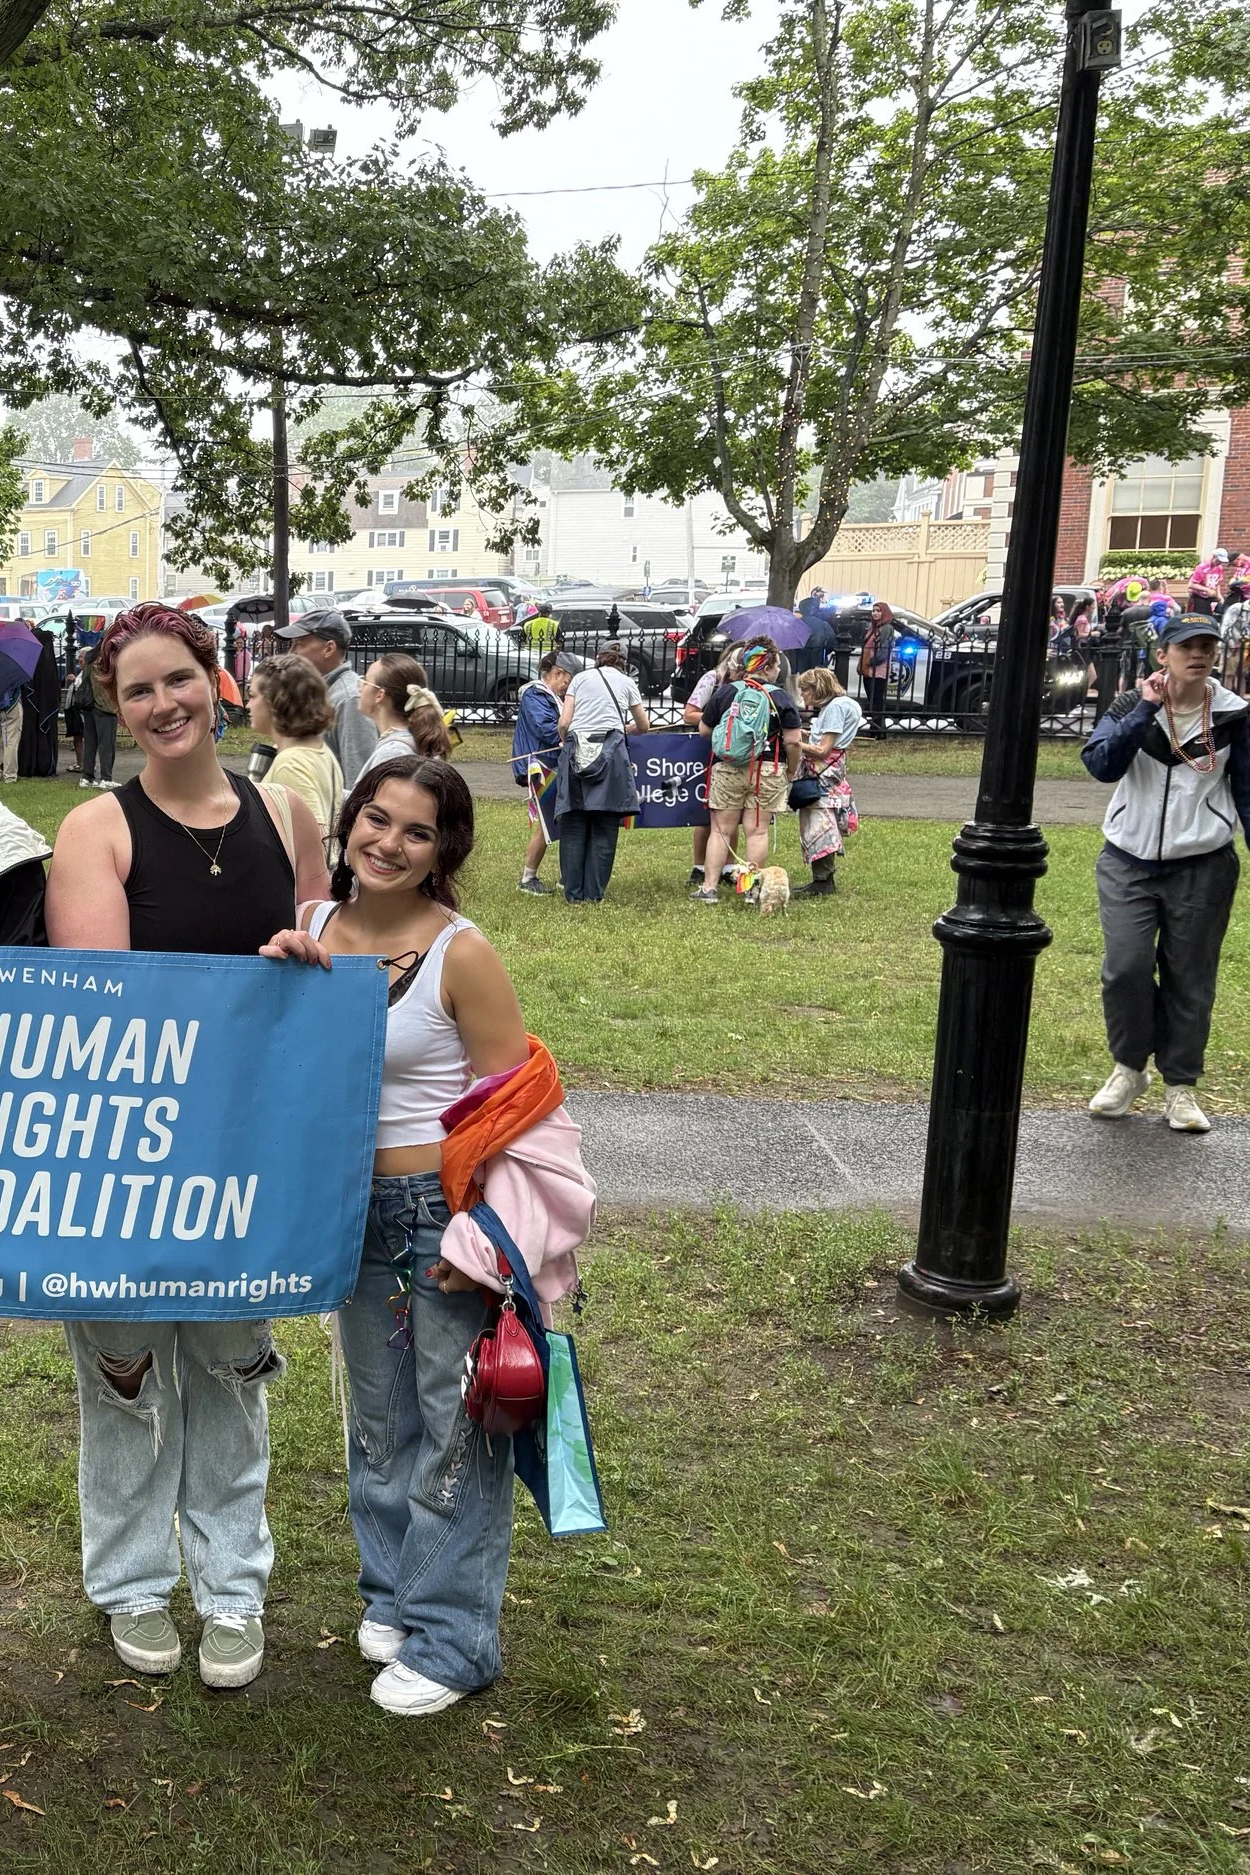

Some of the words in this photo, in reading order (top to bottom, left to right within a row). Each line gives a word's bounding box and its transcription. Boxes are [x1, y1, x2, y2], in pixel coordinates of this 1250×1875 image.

[646, 757, 704, 777] Shore
[636, 784, 689, 807] llege
[41, 1271, 313, 1304] @hwhumanrights
